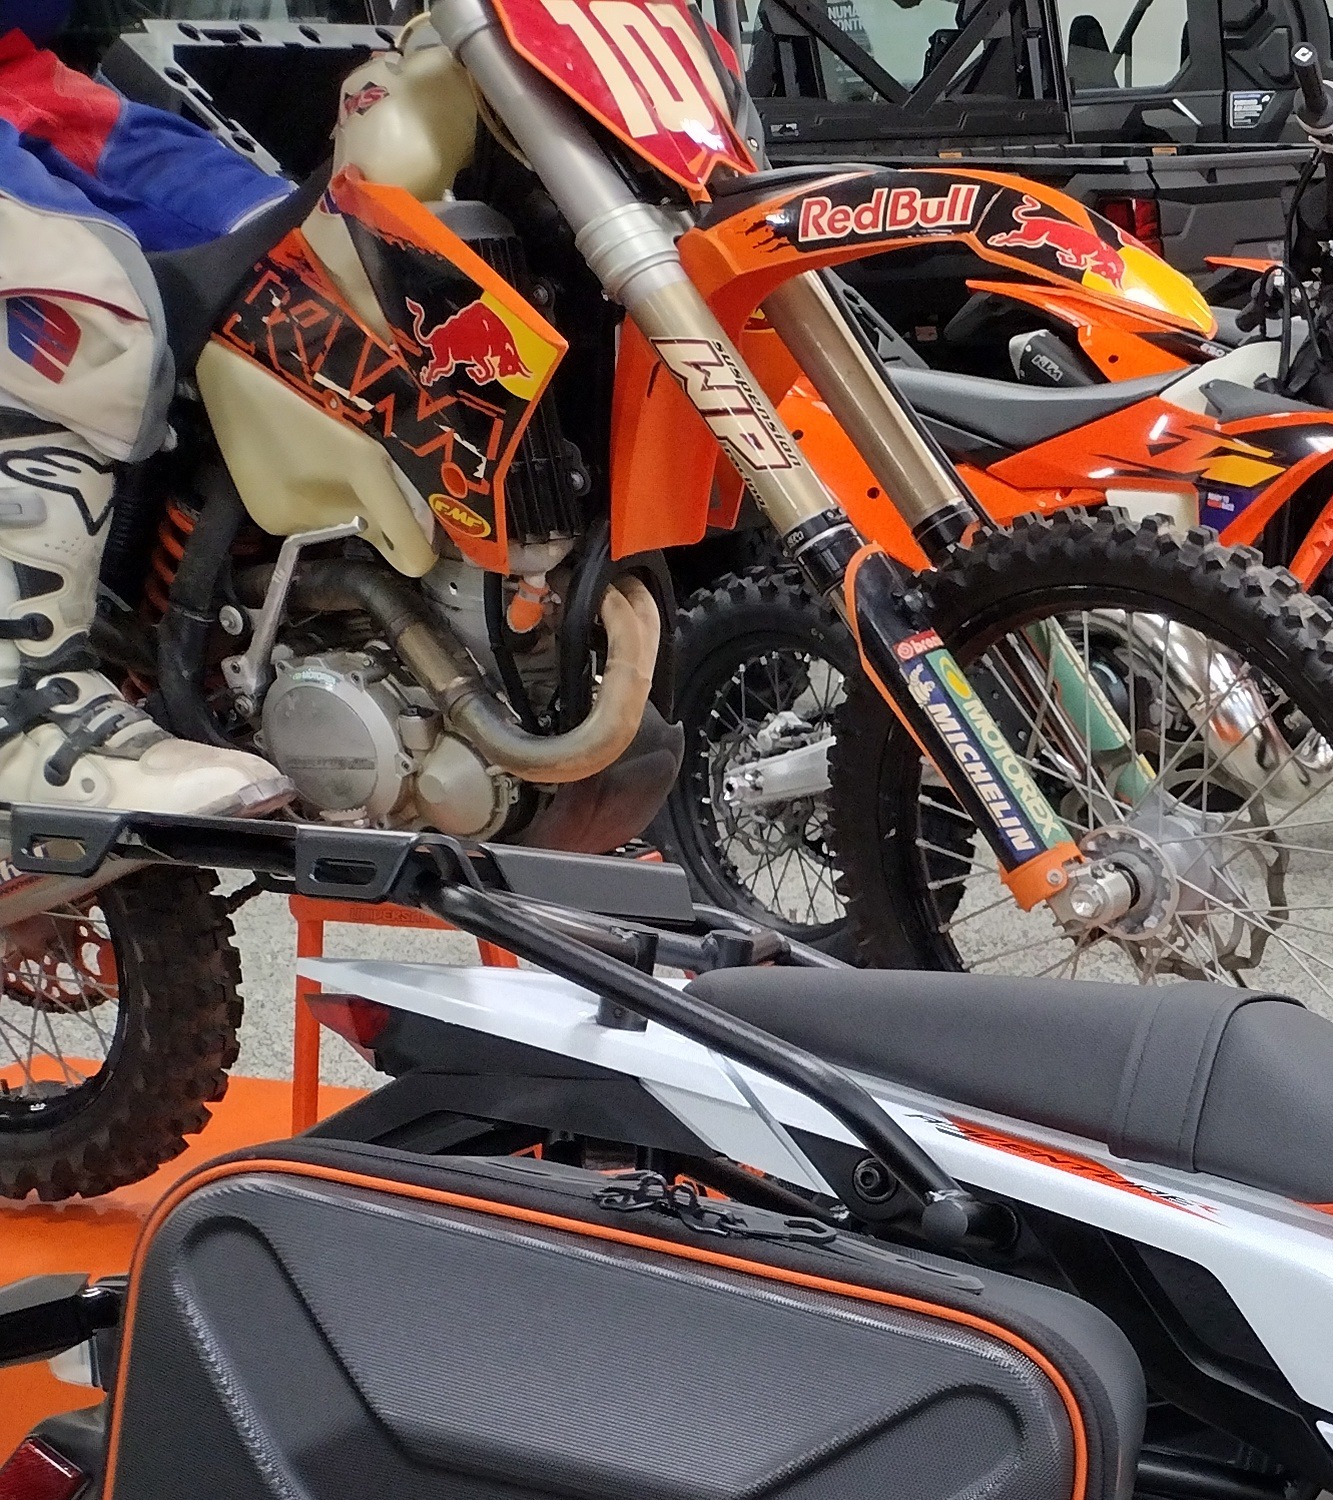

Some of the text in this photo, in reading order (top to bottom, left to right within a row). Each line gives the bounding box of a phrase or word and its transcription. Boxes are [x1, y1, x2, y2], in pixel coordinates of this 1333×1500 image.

[540, 0, 735, 149] 101
[799, 184, 980, 241] Red Bull
[927, 703, 1036, 852] MICHELIN
[963, 698, 1062, 837] MOTOREX
